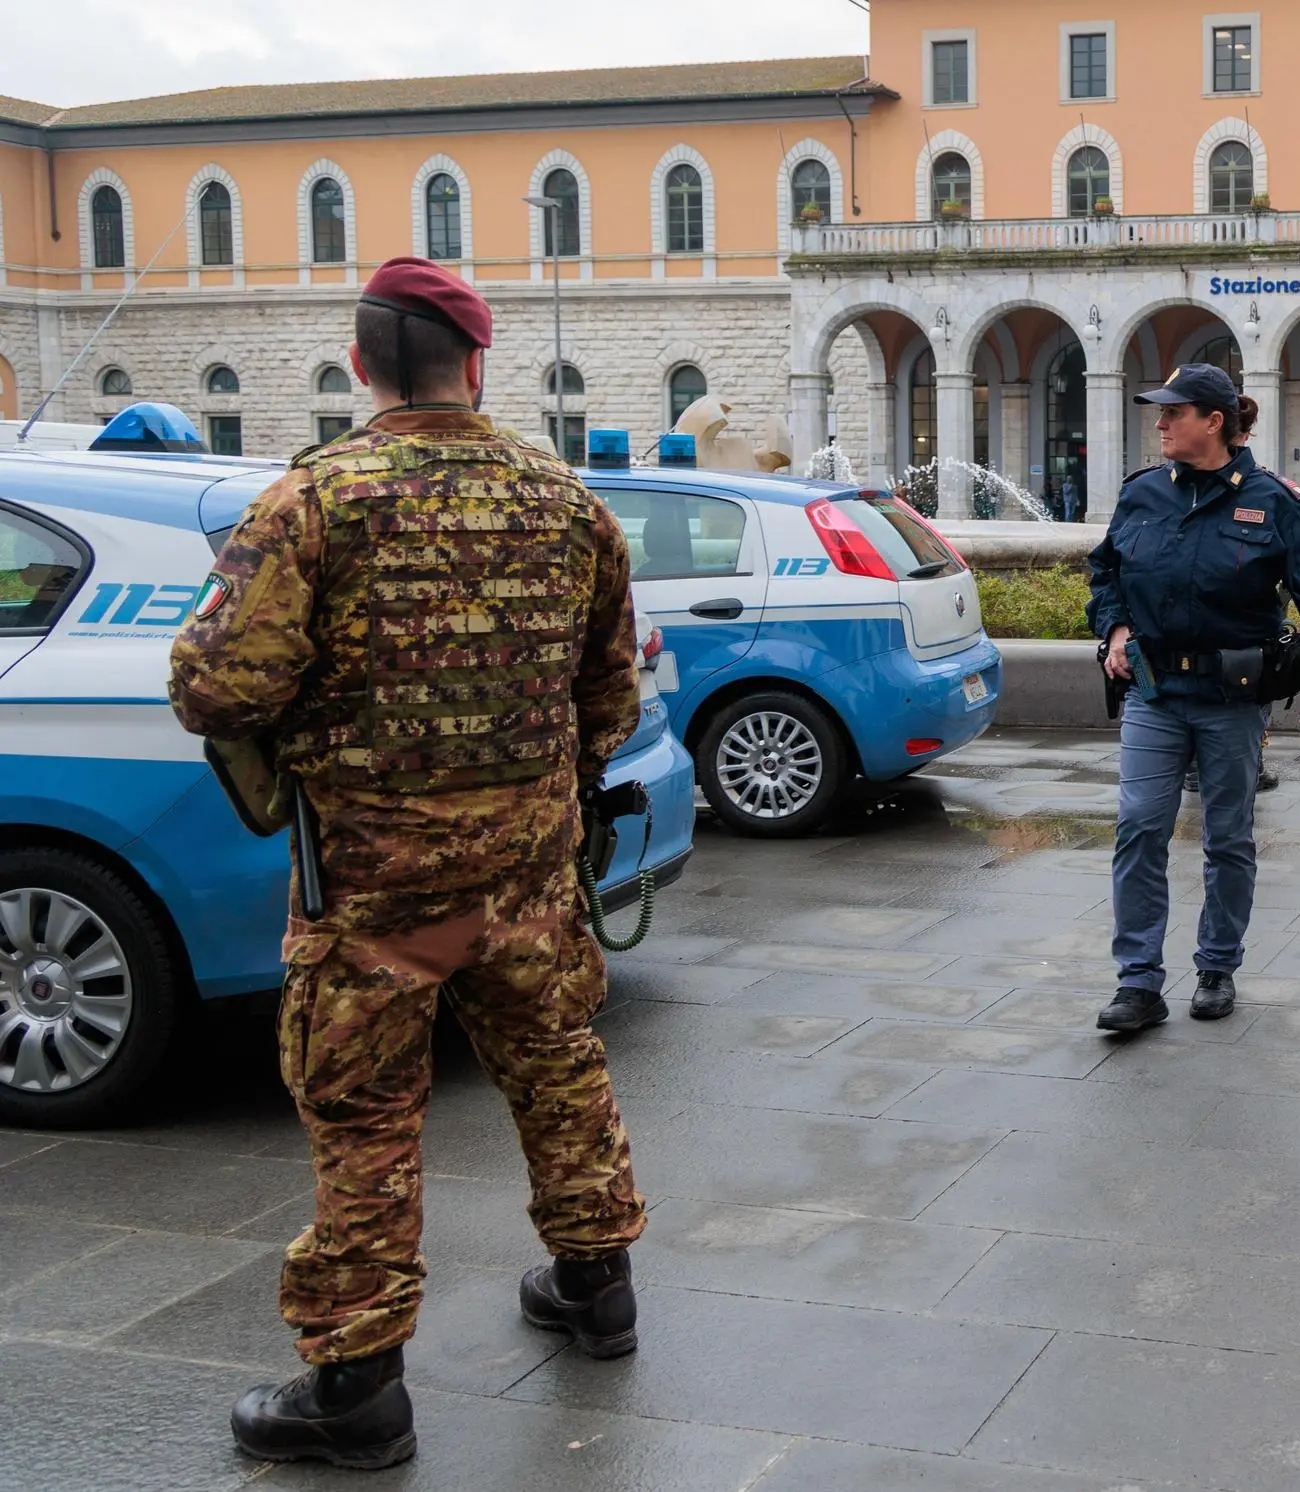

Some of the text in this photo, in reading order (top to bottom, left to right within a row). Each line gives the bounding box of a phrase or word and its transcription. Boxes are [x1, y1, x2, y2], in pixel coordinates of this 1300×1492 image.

[1236, 510, 1263, 520] POLIZIA
[773, 558, 830, 576] 113
[209, 574, 227, 592] ITALIA
[77, 583, 201, 626] 113
